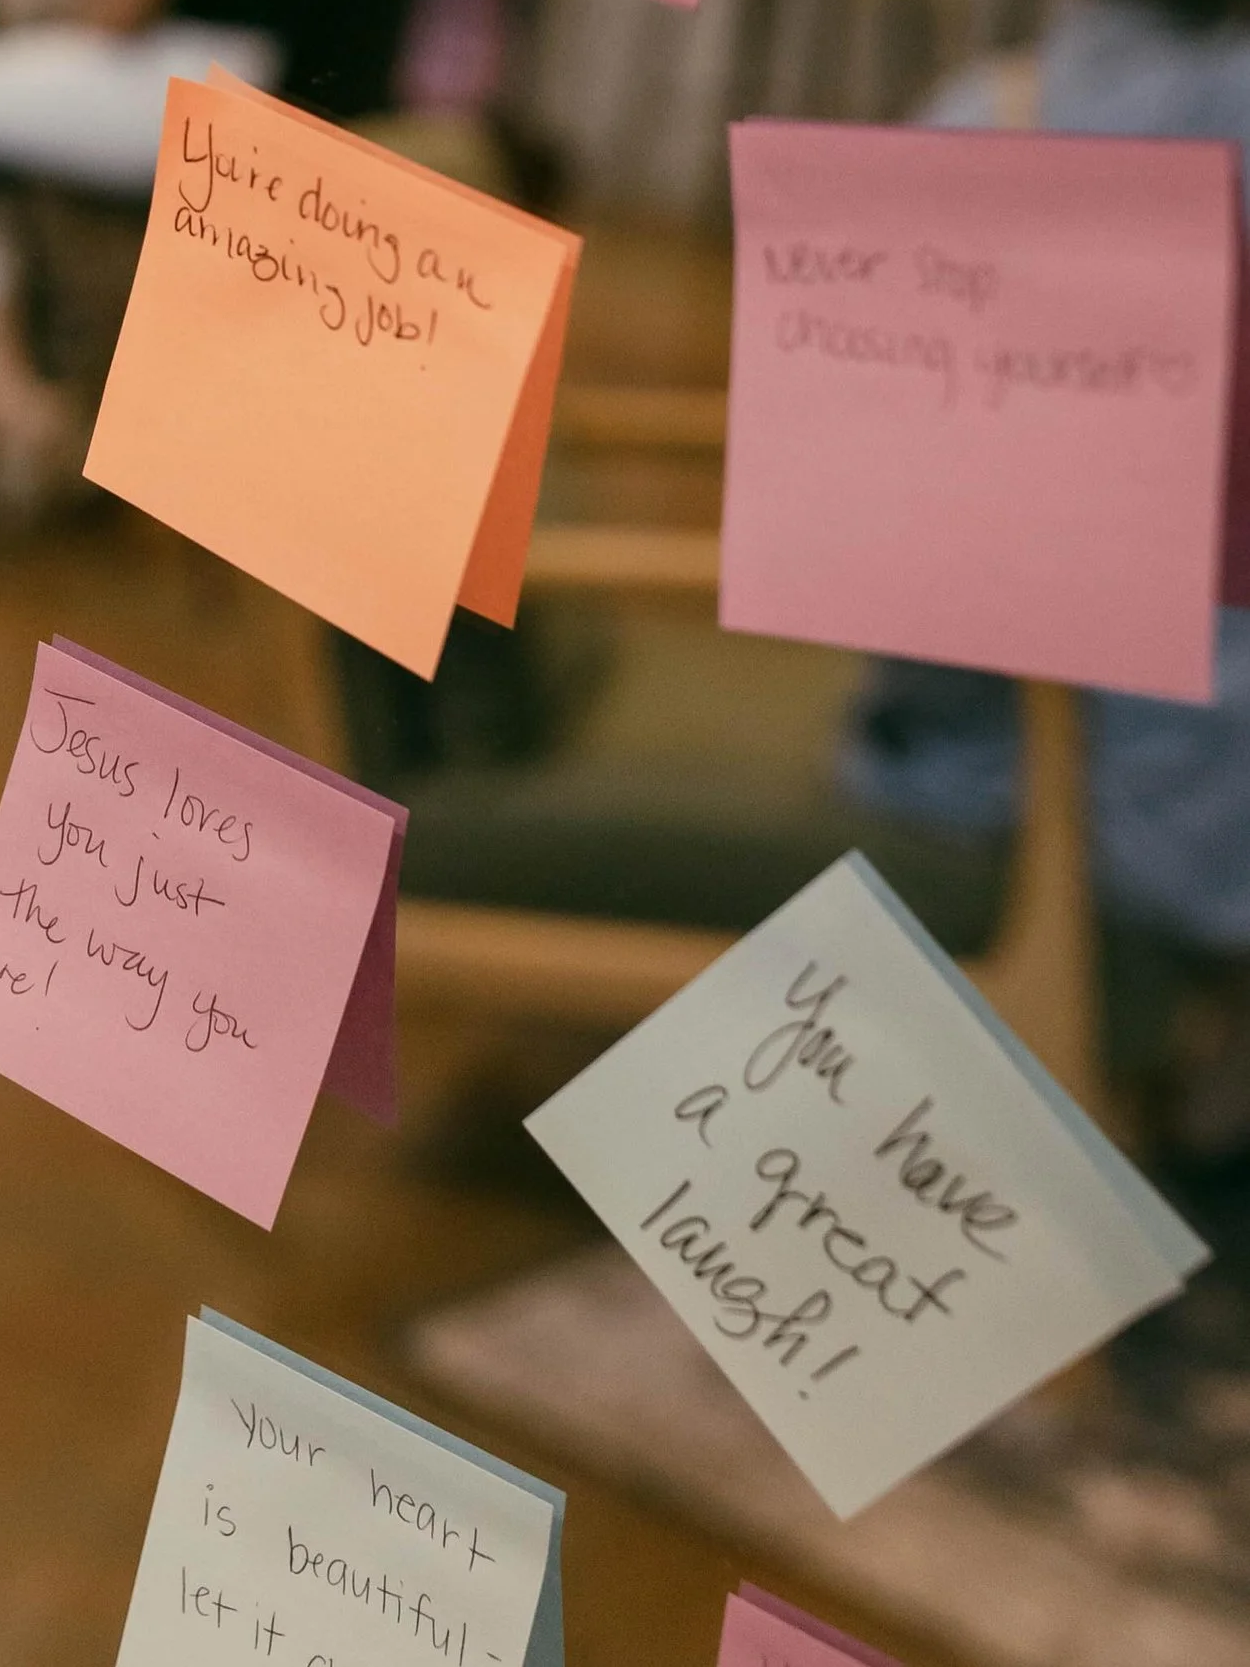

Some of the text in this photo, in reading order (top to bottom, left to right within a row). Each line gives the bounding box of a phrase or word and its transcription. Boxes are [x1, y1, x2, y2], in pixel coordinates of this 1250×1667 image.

[173, 204, 440, 371] amazing job!
[297, 176, 402, 284] doing
[29, 687, 254, 861] Jesus loves
[37, 801, 226, 916] you just
[86, 928, 169, 1031] way
[184, 988, 258, 1052] you
[743, 958, 1020, 1263] You have
[673, 1083, 967, 1325] a great
[639, 1178, 862, 1402] laugh!
[203, 1483, 238, 1537] is
[370, 1468, 496, 1571] heart
[180, 1565, 286, 1656] let it
